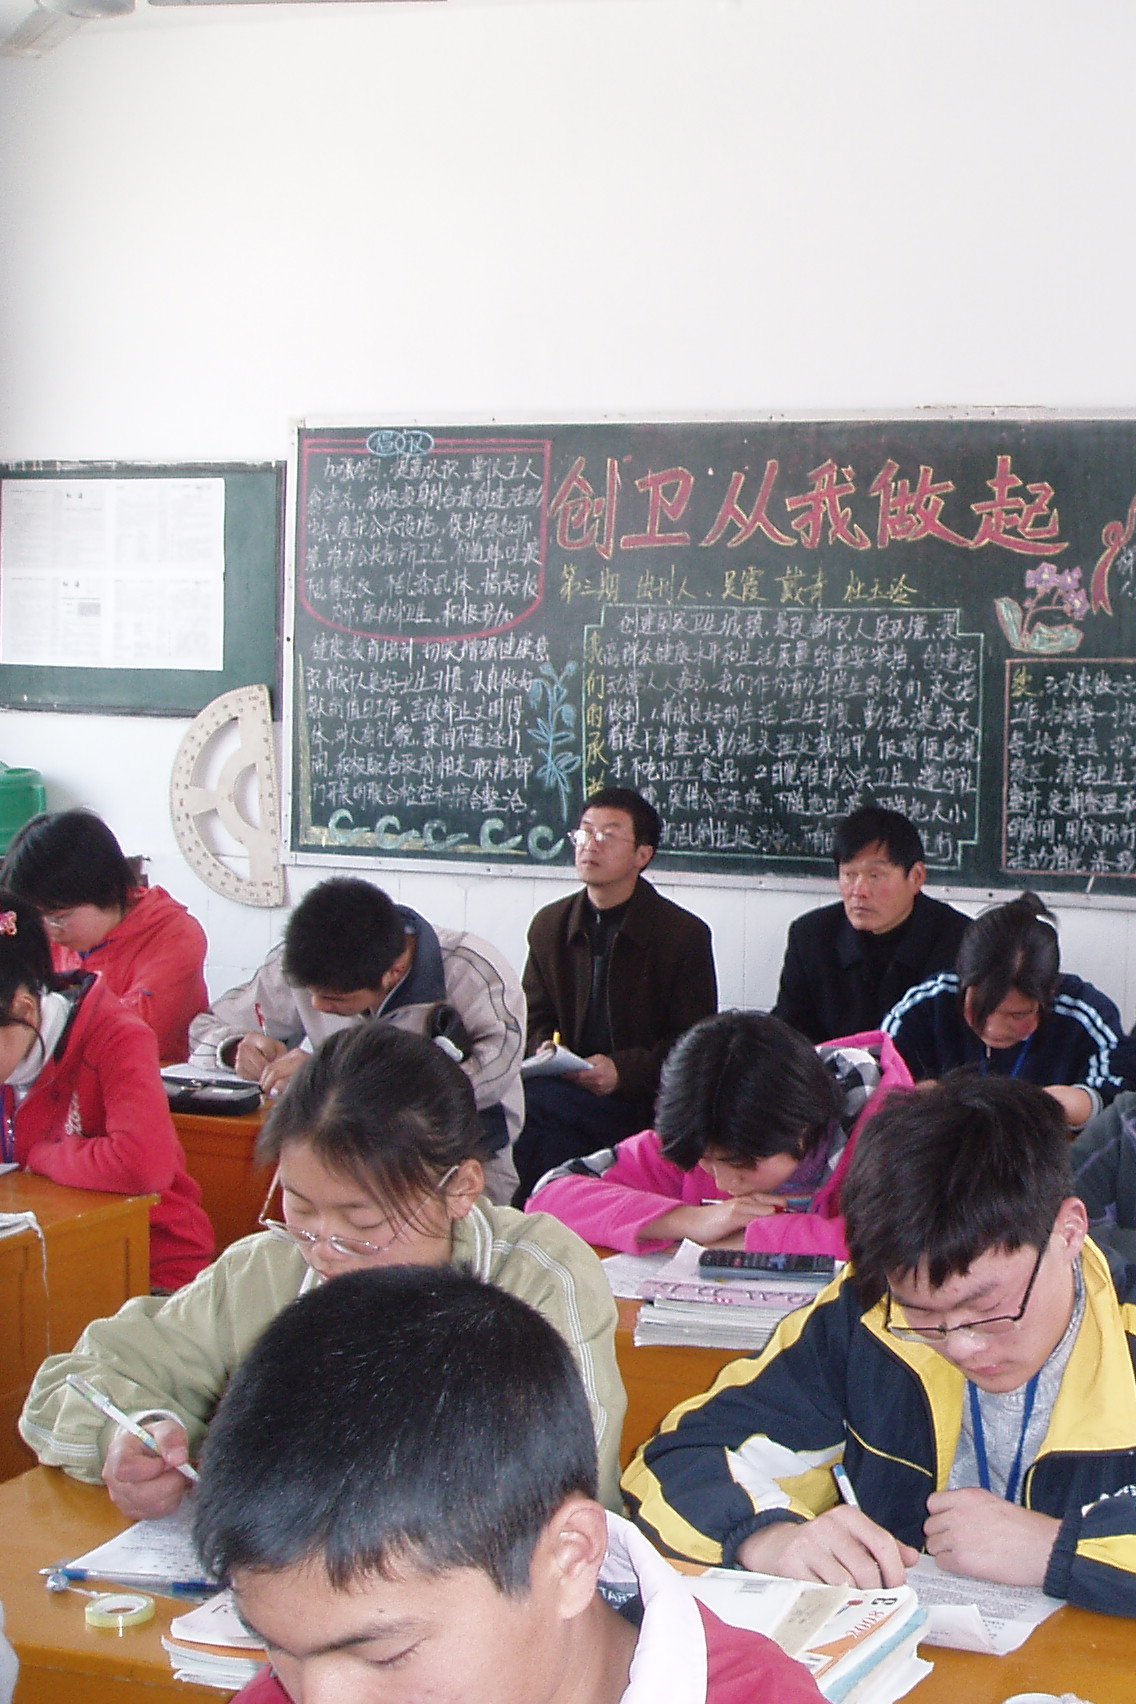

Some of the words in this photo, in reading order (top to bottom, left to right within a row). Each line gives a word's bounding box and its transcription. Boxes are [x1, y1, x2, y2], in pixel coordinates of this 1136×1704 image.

[549, 456, 1069, 559] 创卫从我做起
